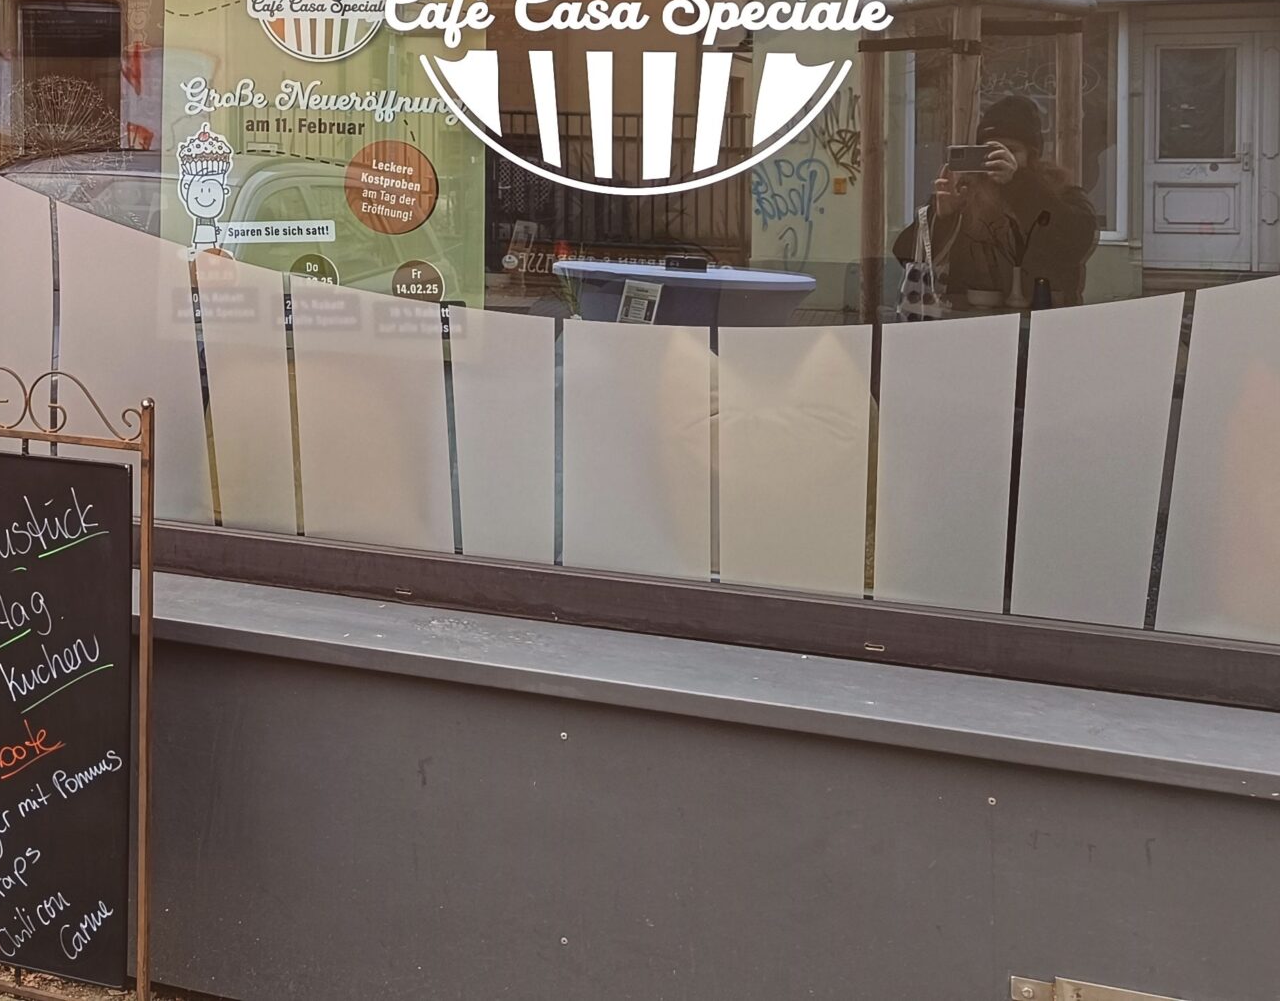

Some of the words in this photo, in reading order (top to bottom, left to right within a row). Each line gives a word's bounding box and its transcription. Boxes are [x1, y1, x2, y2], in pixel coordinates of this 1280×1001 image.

[179, 76, 268, 115] Große
[245, 118, 271, 134] am
[274, 117, 294, 134] 11.
[297, 117, 365, 136] Februar
[371, 159, 414, 176] Leckere
[360, 171, 422, 194] Kostproben
[361, 188, 378, 200] am
[378, 188, 398, 206] Tag
[398, 192, 418, 207] der
[360, 200, 414, 221] Eröffnung!
[227, 226, 263, 240] Sparen
[264, 225, 281, 238] Sie
[282, 224, 304, 237] sich
[305, 224, 330, 237] satt!
[306, 262, 319, 272] Do
[411, 268, 422, 279] Fr
[396, 284, 439, 294] 14.02.25
[0, 634, 100, 702] Kuchen
[18, 783, 52, 818] mit
